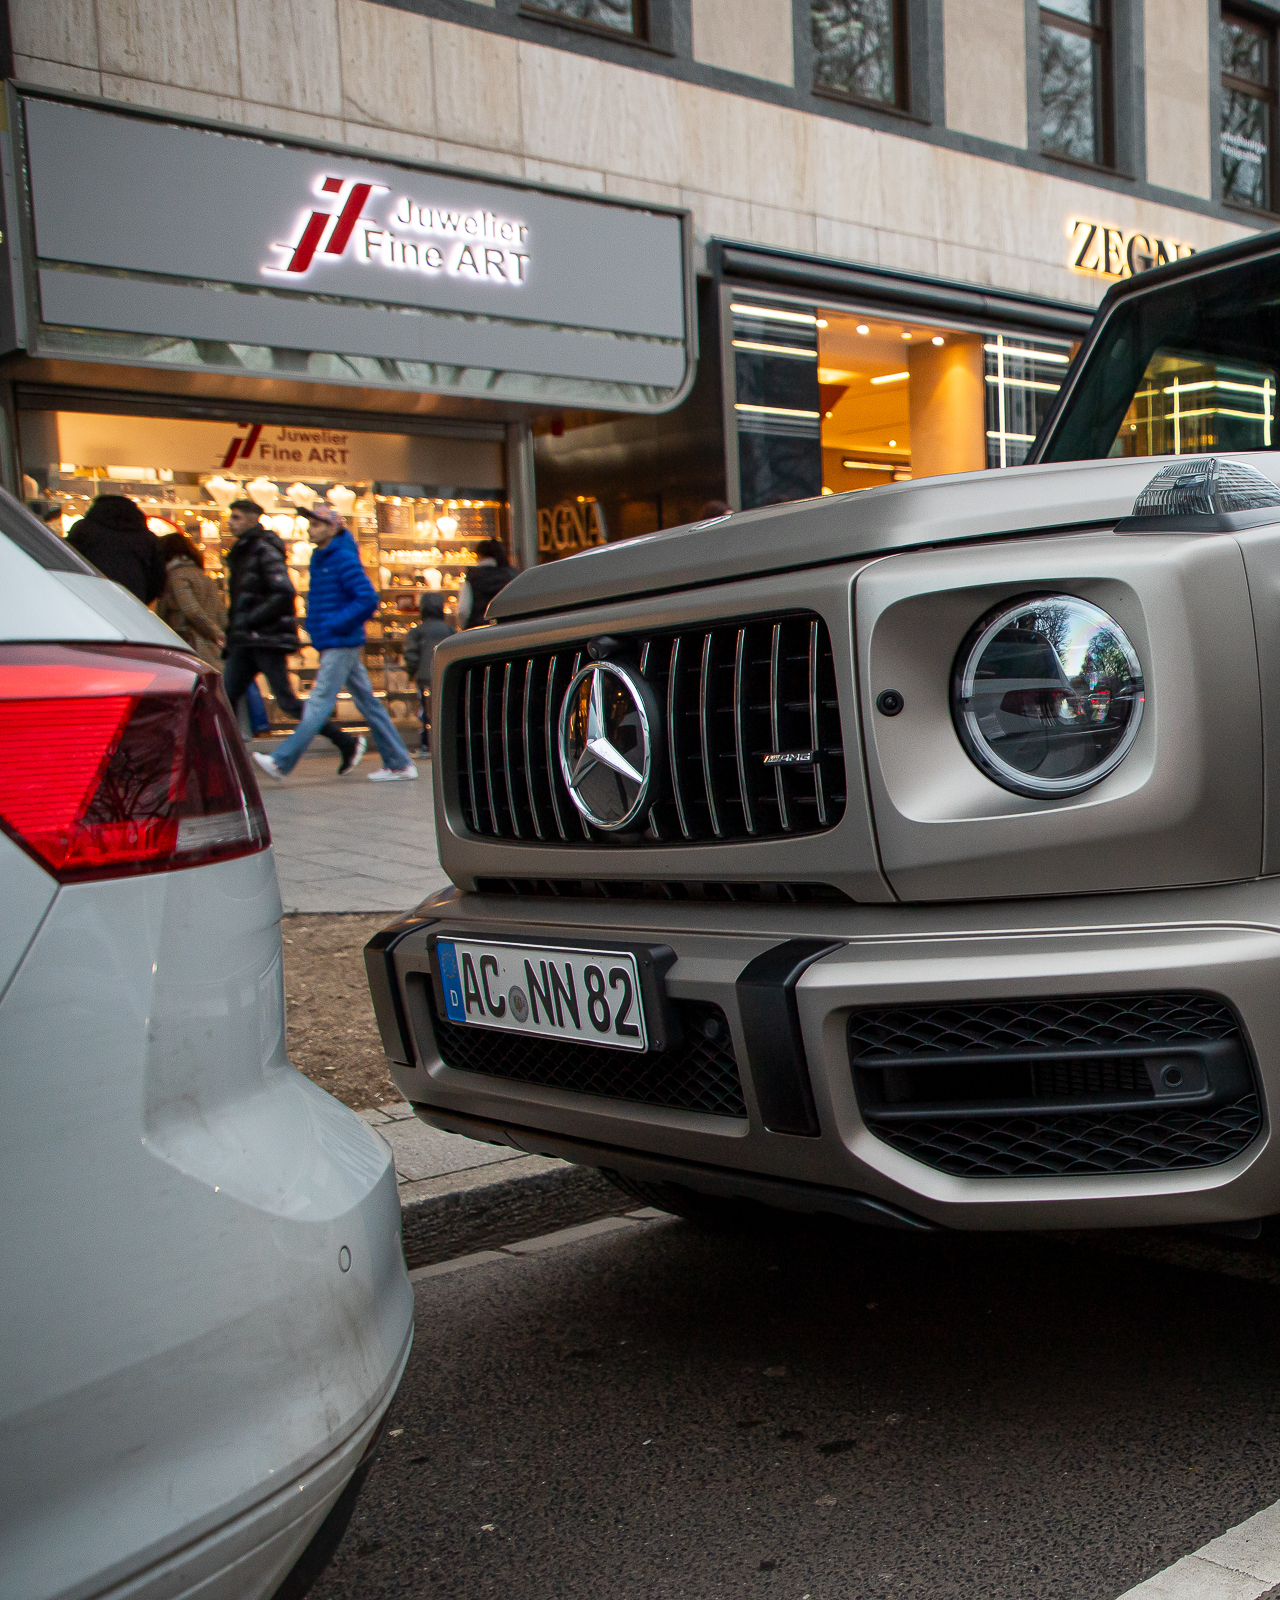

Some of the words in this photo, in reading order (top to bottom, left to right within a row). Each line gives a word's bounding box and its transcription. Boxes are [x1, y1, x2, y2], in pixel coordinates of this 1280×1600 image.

[396, 198, 530, 244] Juwelier
[363, 229, 443, 269] Fine
[456, 244, 531, 283] ART
[259, 444, 303, 462] Fine
[308, 448, 350, 465] ART
[277, 427, 349, 445] Juwelier
[450, 990, 459, 1007] D
[461, 952, 507, 1018] AC
[523, 957, 583, 1030] NN
[583, 964, 641, 1037] 82
